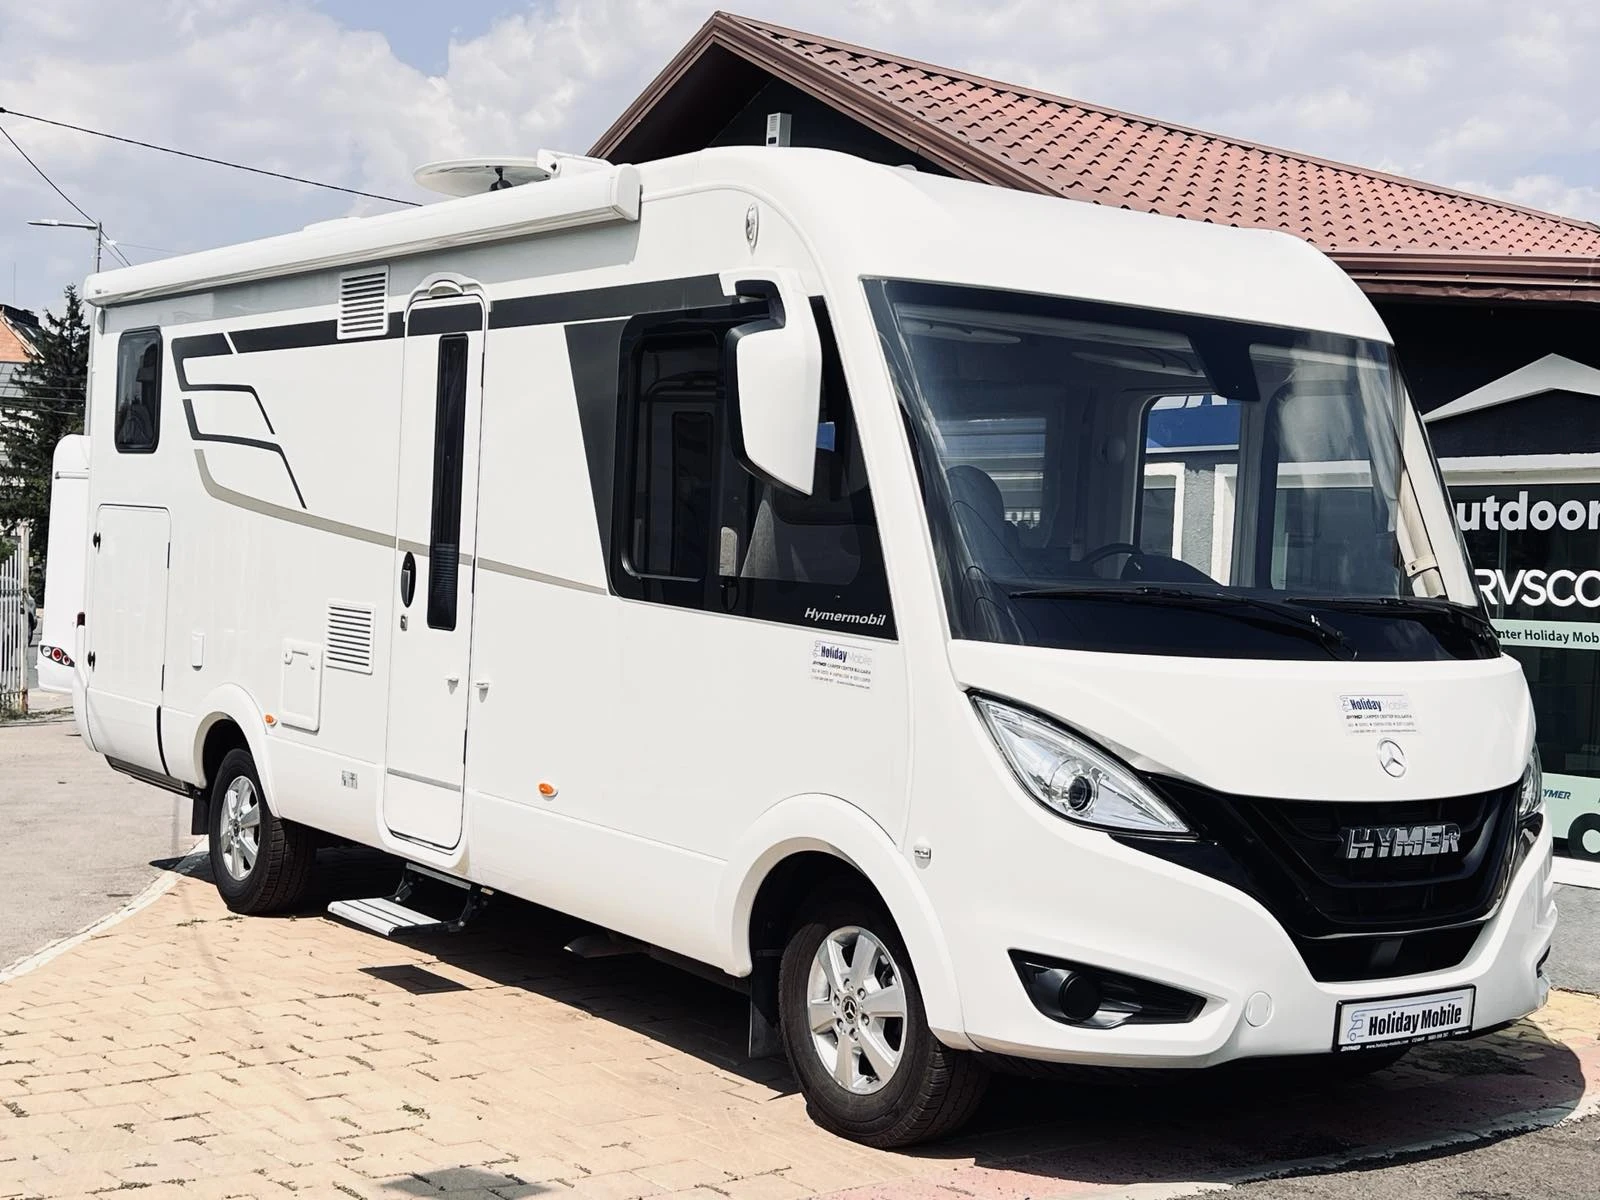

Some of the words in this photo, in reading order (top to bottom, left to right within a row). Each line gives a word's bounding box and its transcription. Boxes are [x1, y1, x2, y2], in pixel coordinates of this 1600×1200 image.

[804, 607, 886, 626] Hymermobil
[1496, 629, 1522, 640] nter
[1524, 629, 1570, 644] Holiday
[1572, 631, 1600, 643] Mob
[821, 645, 848, 663] Holiday
[1350, 697, 1382, 711] Holiday
[1543, 789, 1571, 800] YMER
[1346, 823, 1461, 859] HYMER
[1368, 1011, 1420, 1036] Holiday
[1420, 1003, 1462, 1029] Mobile
